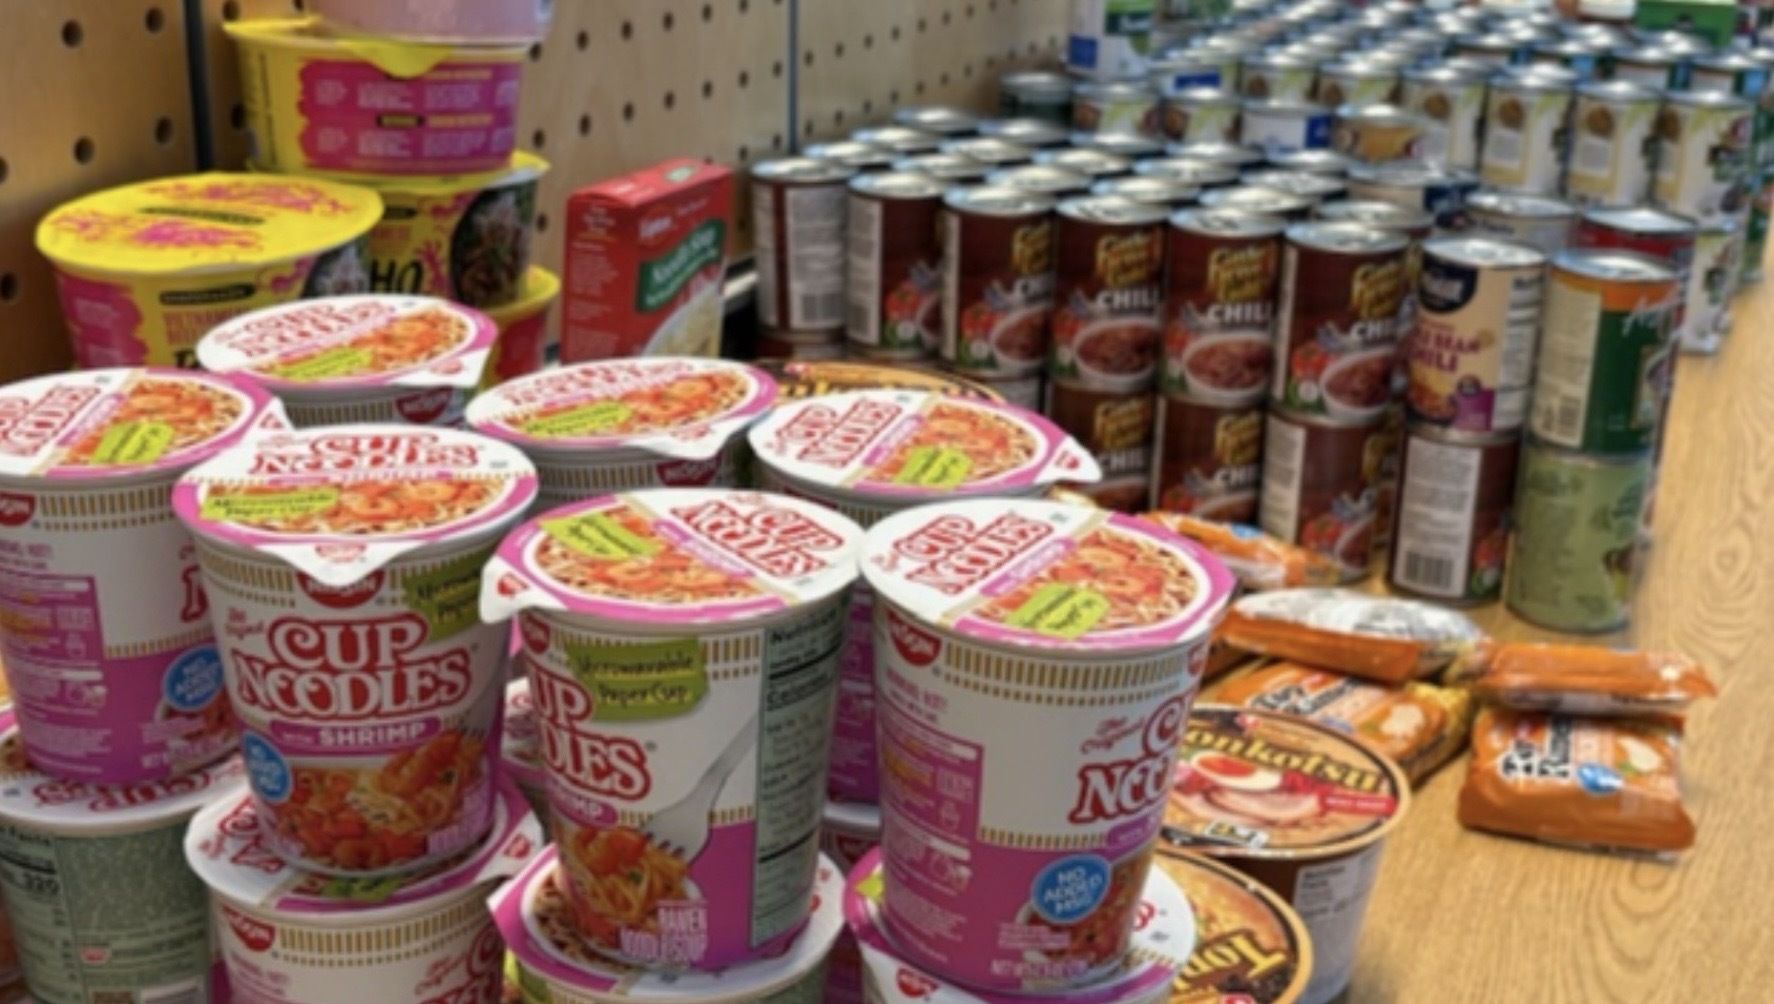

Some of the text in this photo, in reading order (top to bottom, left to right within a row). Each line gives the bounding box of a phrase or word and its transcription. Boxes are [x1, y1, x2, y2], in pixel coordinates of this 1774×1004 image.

[268, 612, 430, 672] CUP
[231, 647, 472, 720] NOODLES
[317, 721, 427, 748] SHRIMP
[542, 722, 652, 803] DLES
[1186, 727, 1382, 793] onkotsu
[1044, 874, 1105, 902] ADDED
[1057, 866, 1087, 887] NO
[1054, 892, 1094, 914] MSG
